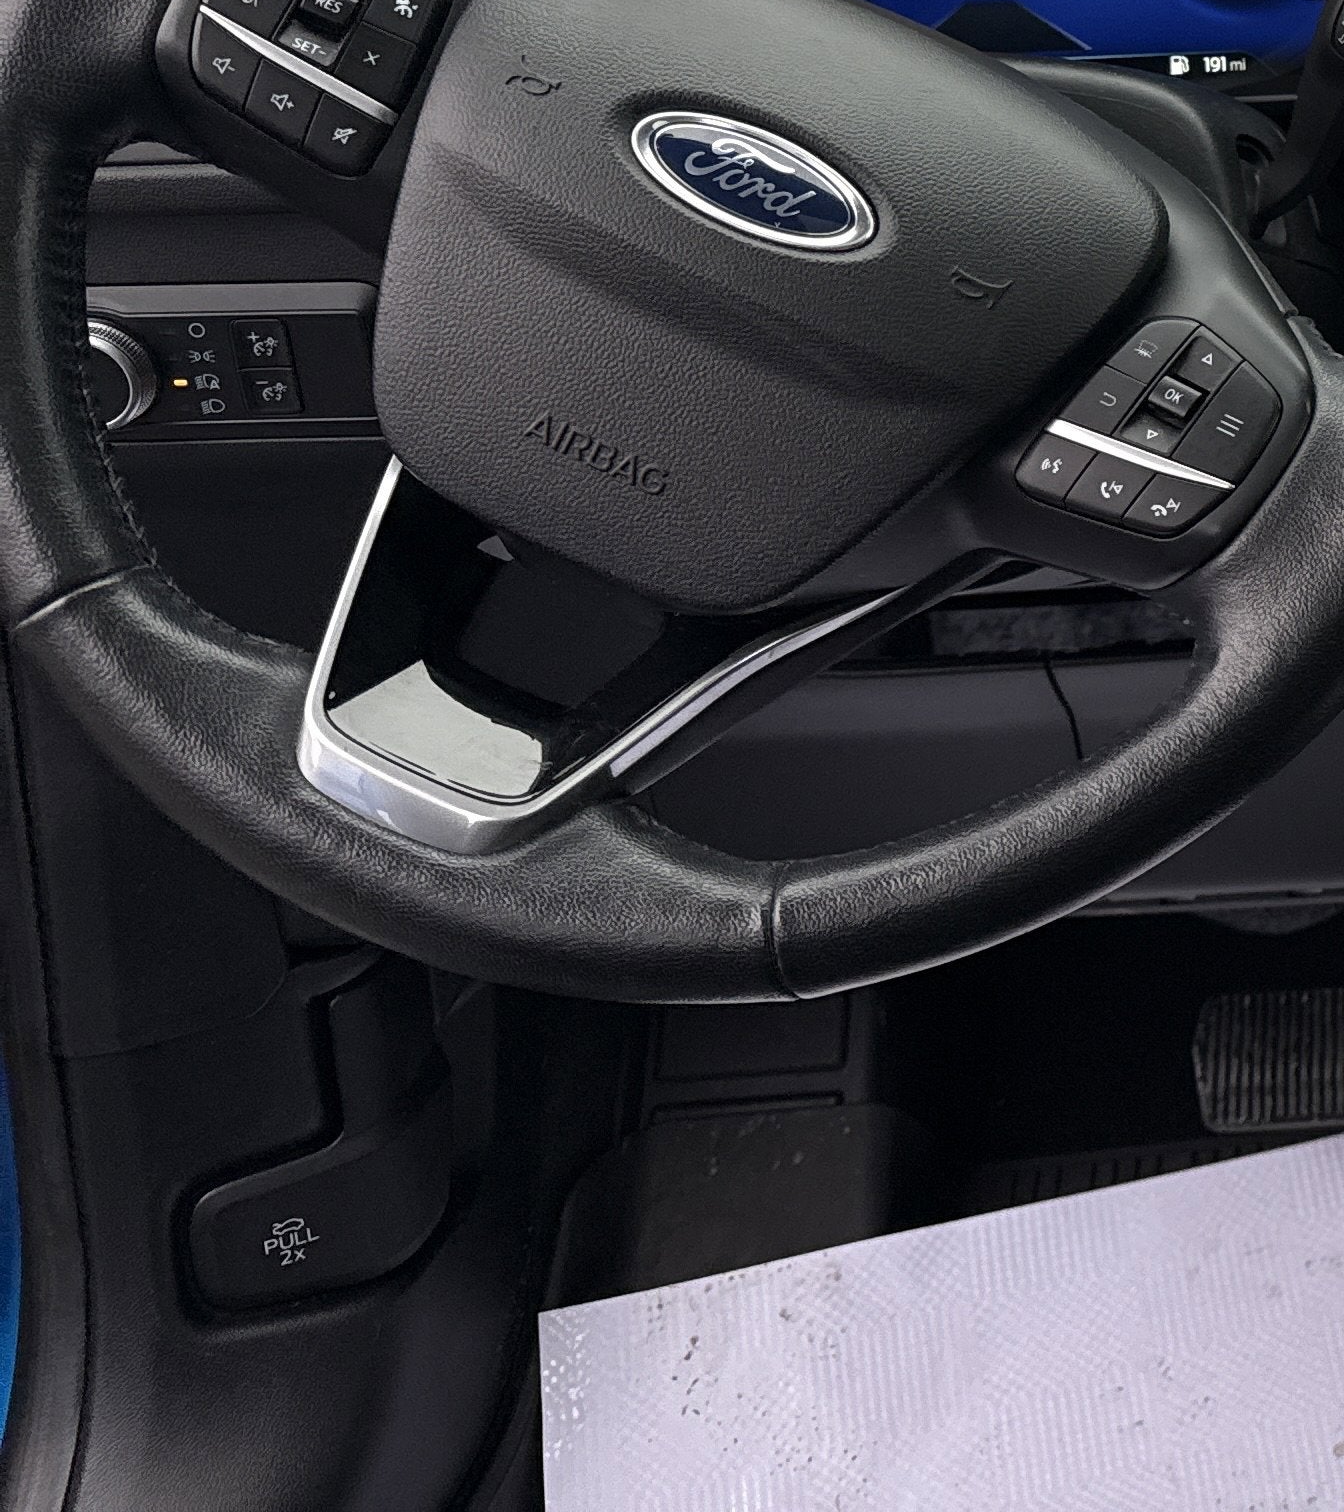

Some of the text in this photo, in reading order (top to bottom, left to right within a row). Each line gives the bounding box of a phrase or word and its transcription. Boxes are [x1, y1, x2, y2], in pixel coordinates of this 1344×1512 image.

[1203, 56, 1246, 72] 191 mi
[684, 137, 816, 219] Ford
[1164, 389, 1184, 404] OK
[523, 414, 670, 496] AIRBAG
[263, 1227, 320, 1256] PULL
